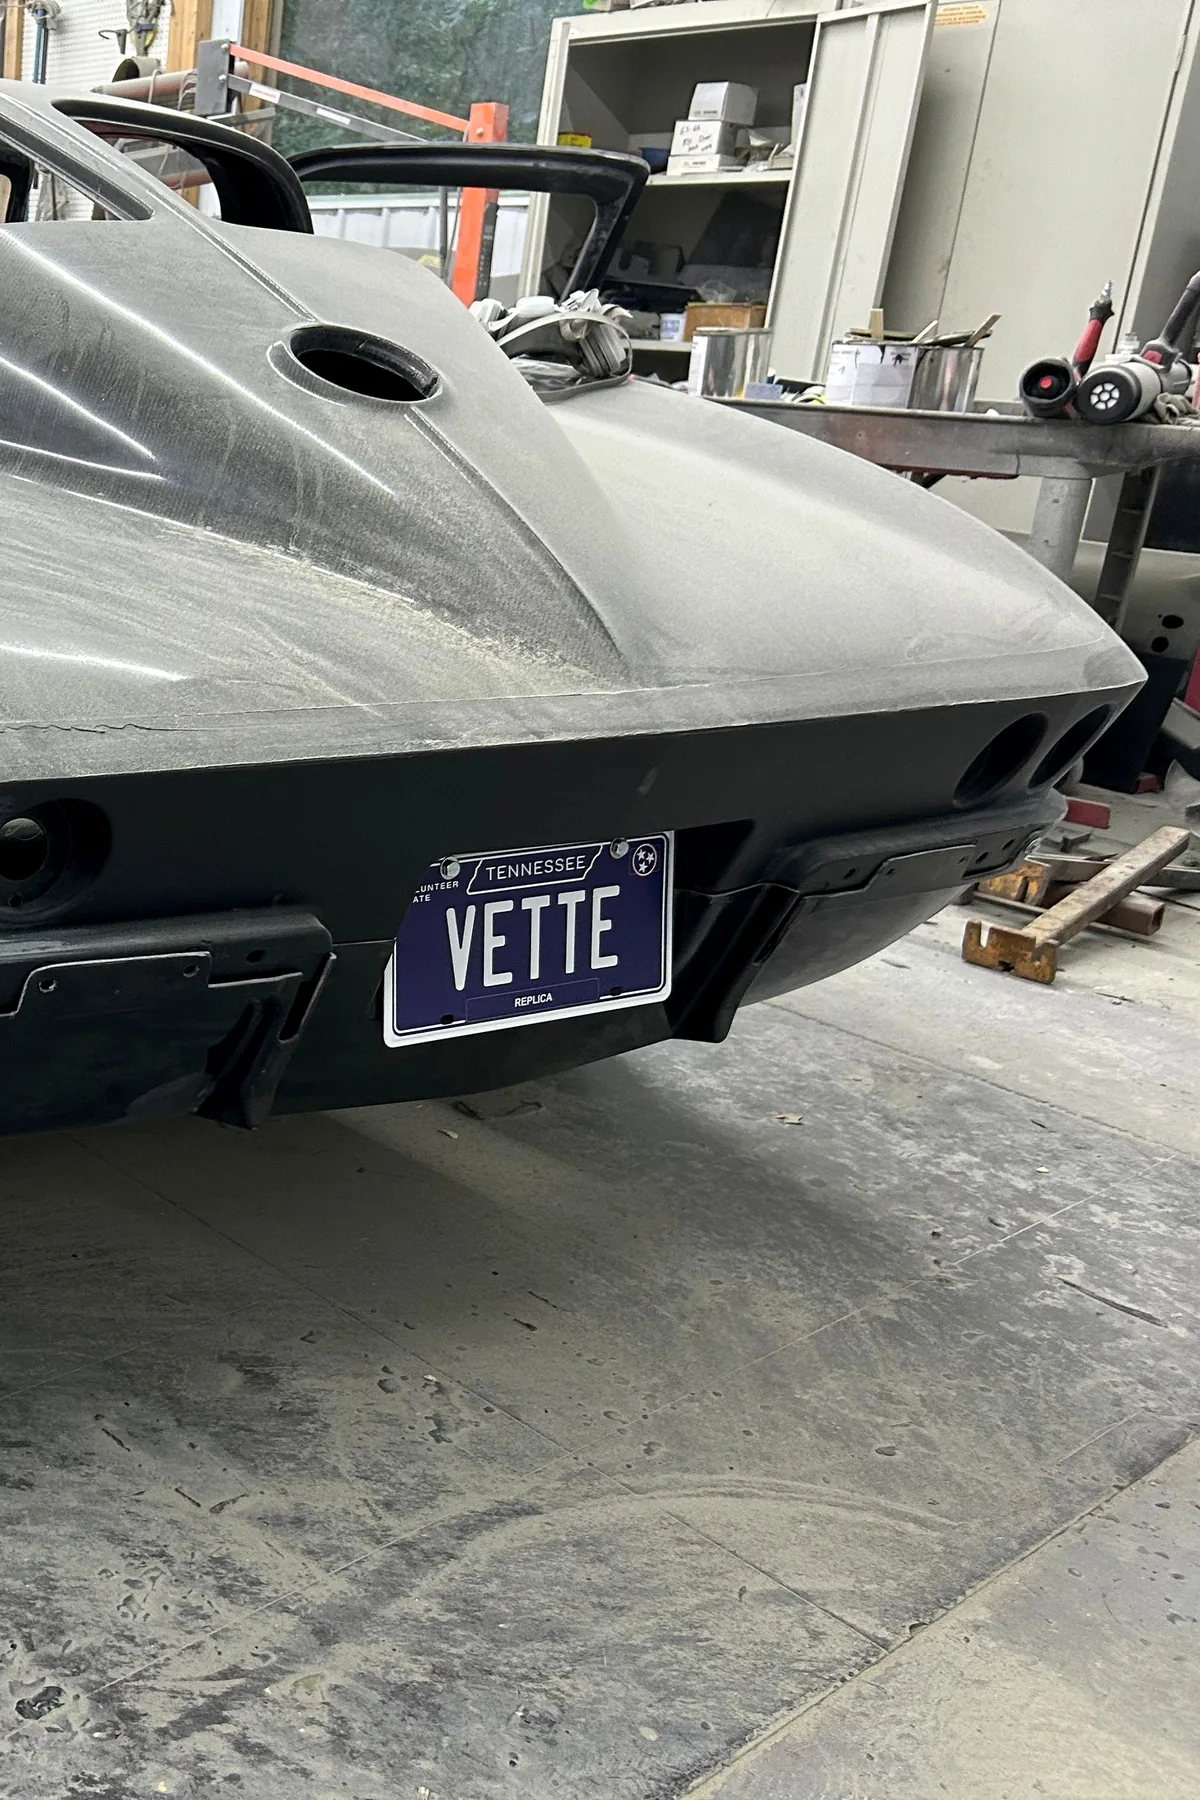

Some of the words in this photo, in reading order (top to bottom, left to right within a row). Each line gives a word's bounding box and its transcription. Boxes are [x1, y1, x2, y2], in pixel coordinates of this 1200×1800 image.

[485, 855, 586, 881] TENNESSEE
[414, 880, 459, 894] UNTEER
[446, 885, 620, 991] VETTE
[514, 992, 553, 1008] REPLICA
